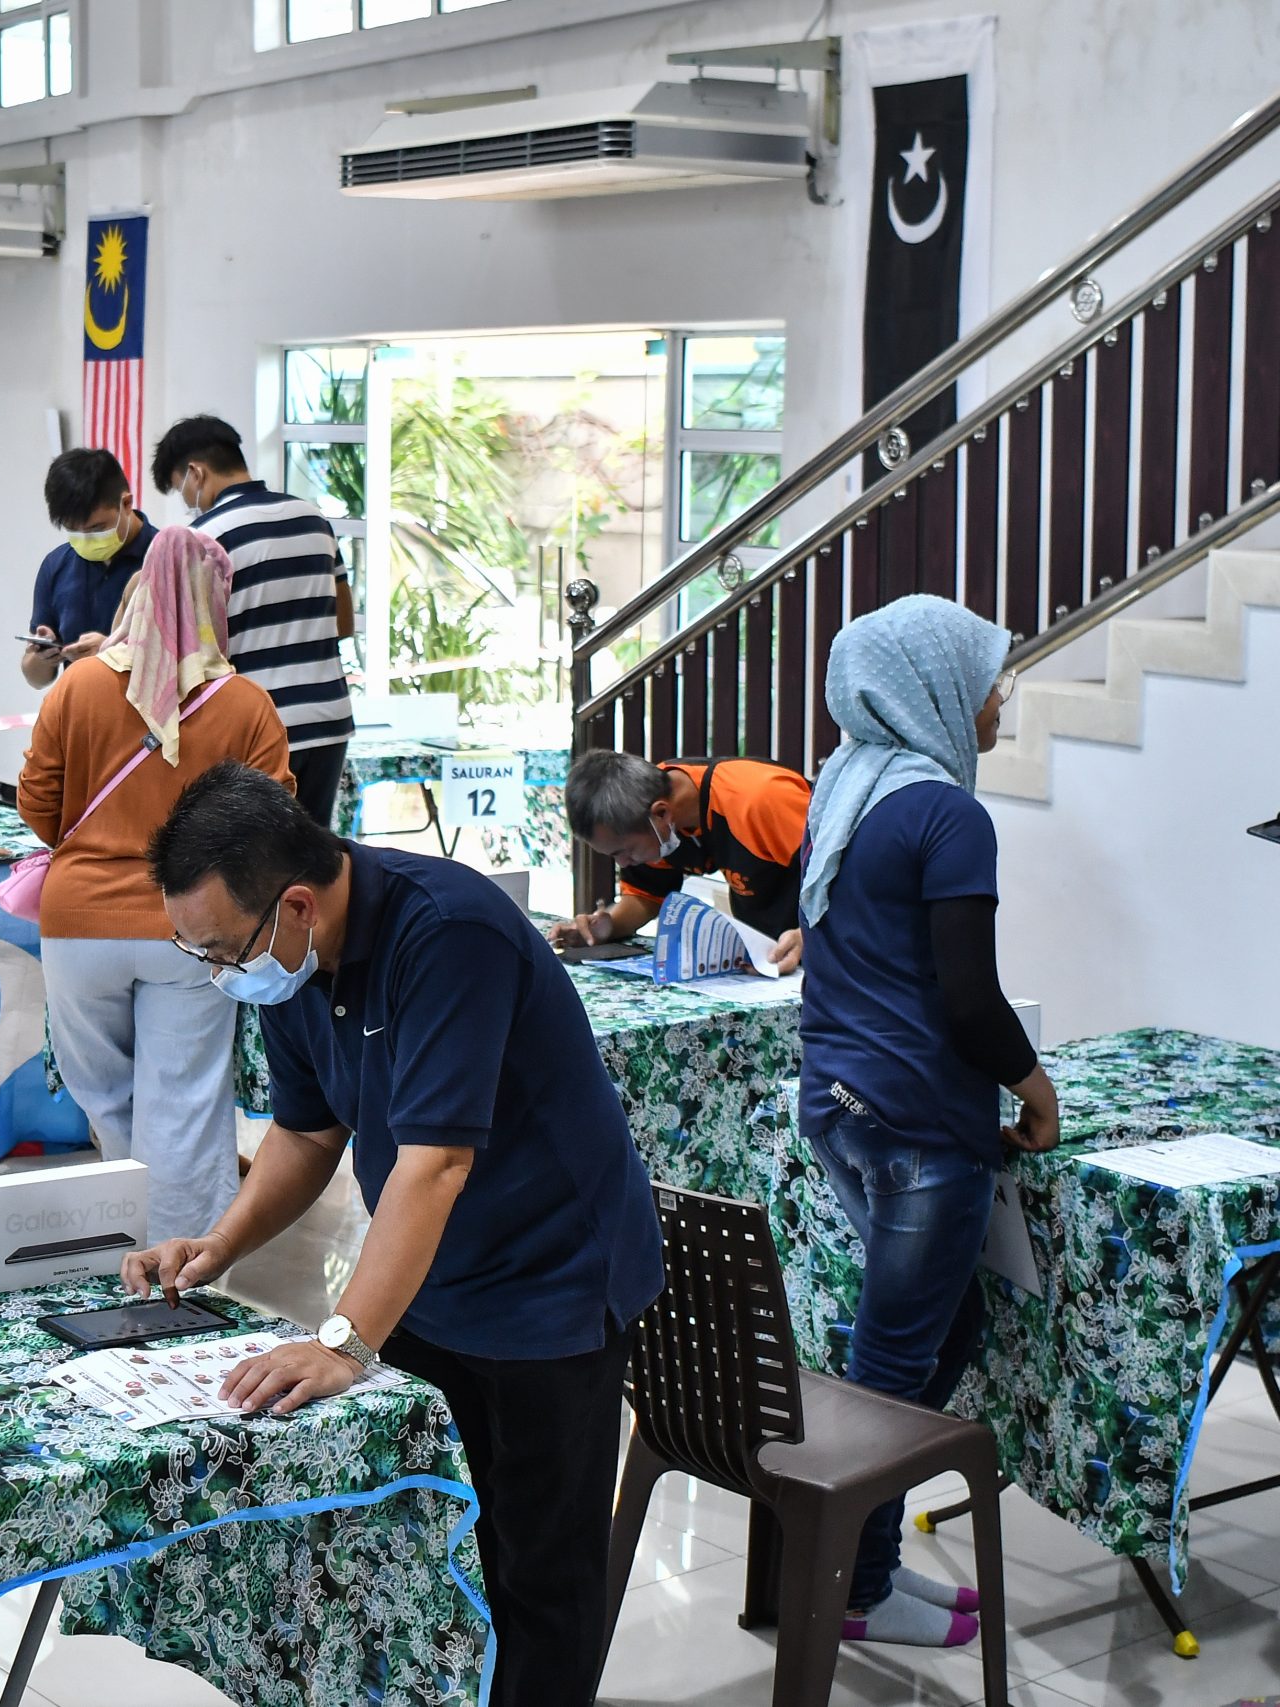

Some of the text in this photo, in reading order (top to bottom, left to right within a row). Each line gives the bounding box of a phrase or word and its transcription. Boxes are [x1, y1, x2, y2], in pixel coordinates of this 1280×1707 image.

[451, 766, 513, 779] SALURAN
[467, 789, 496, 816] 12
[6, 1199, 137, 1234] Galaxy Tab
